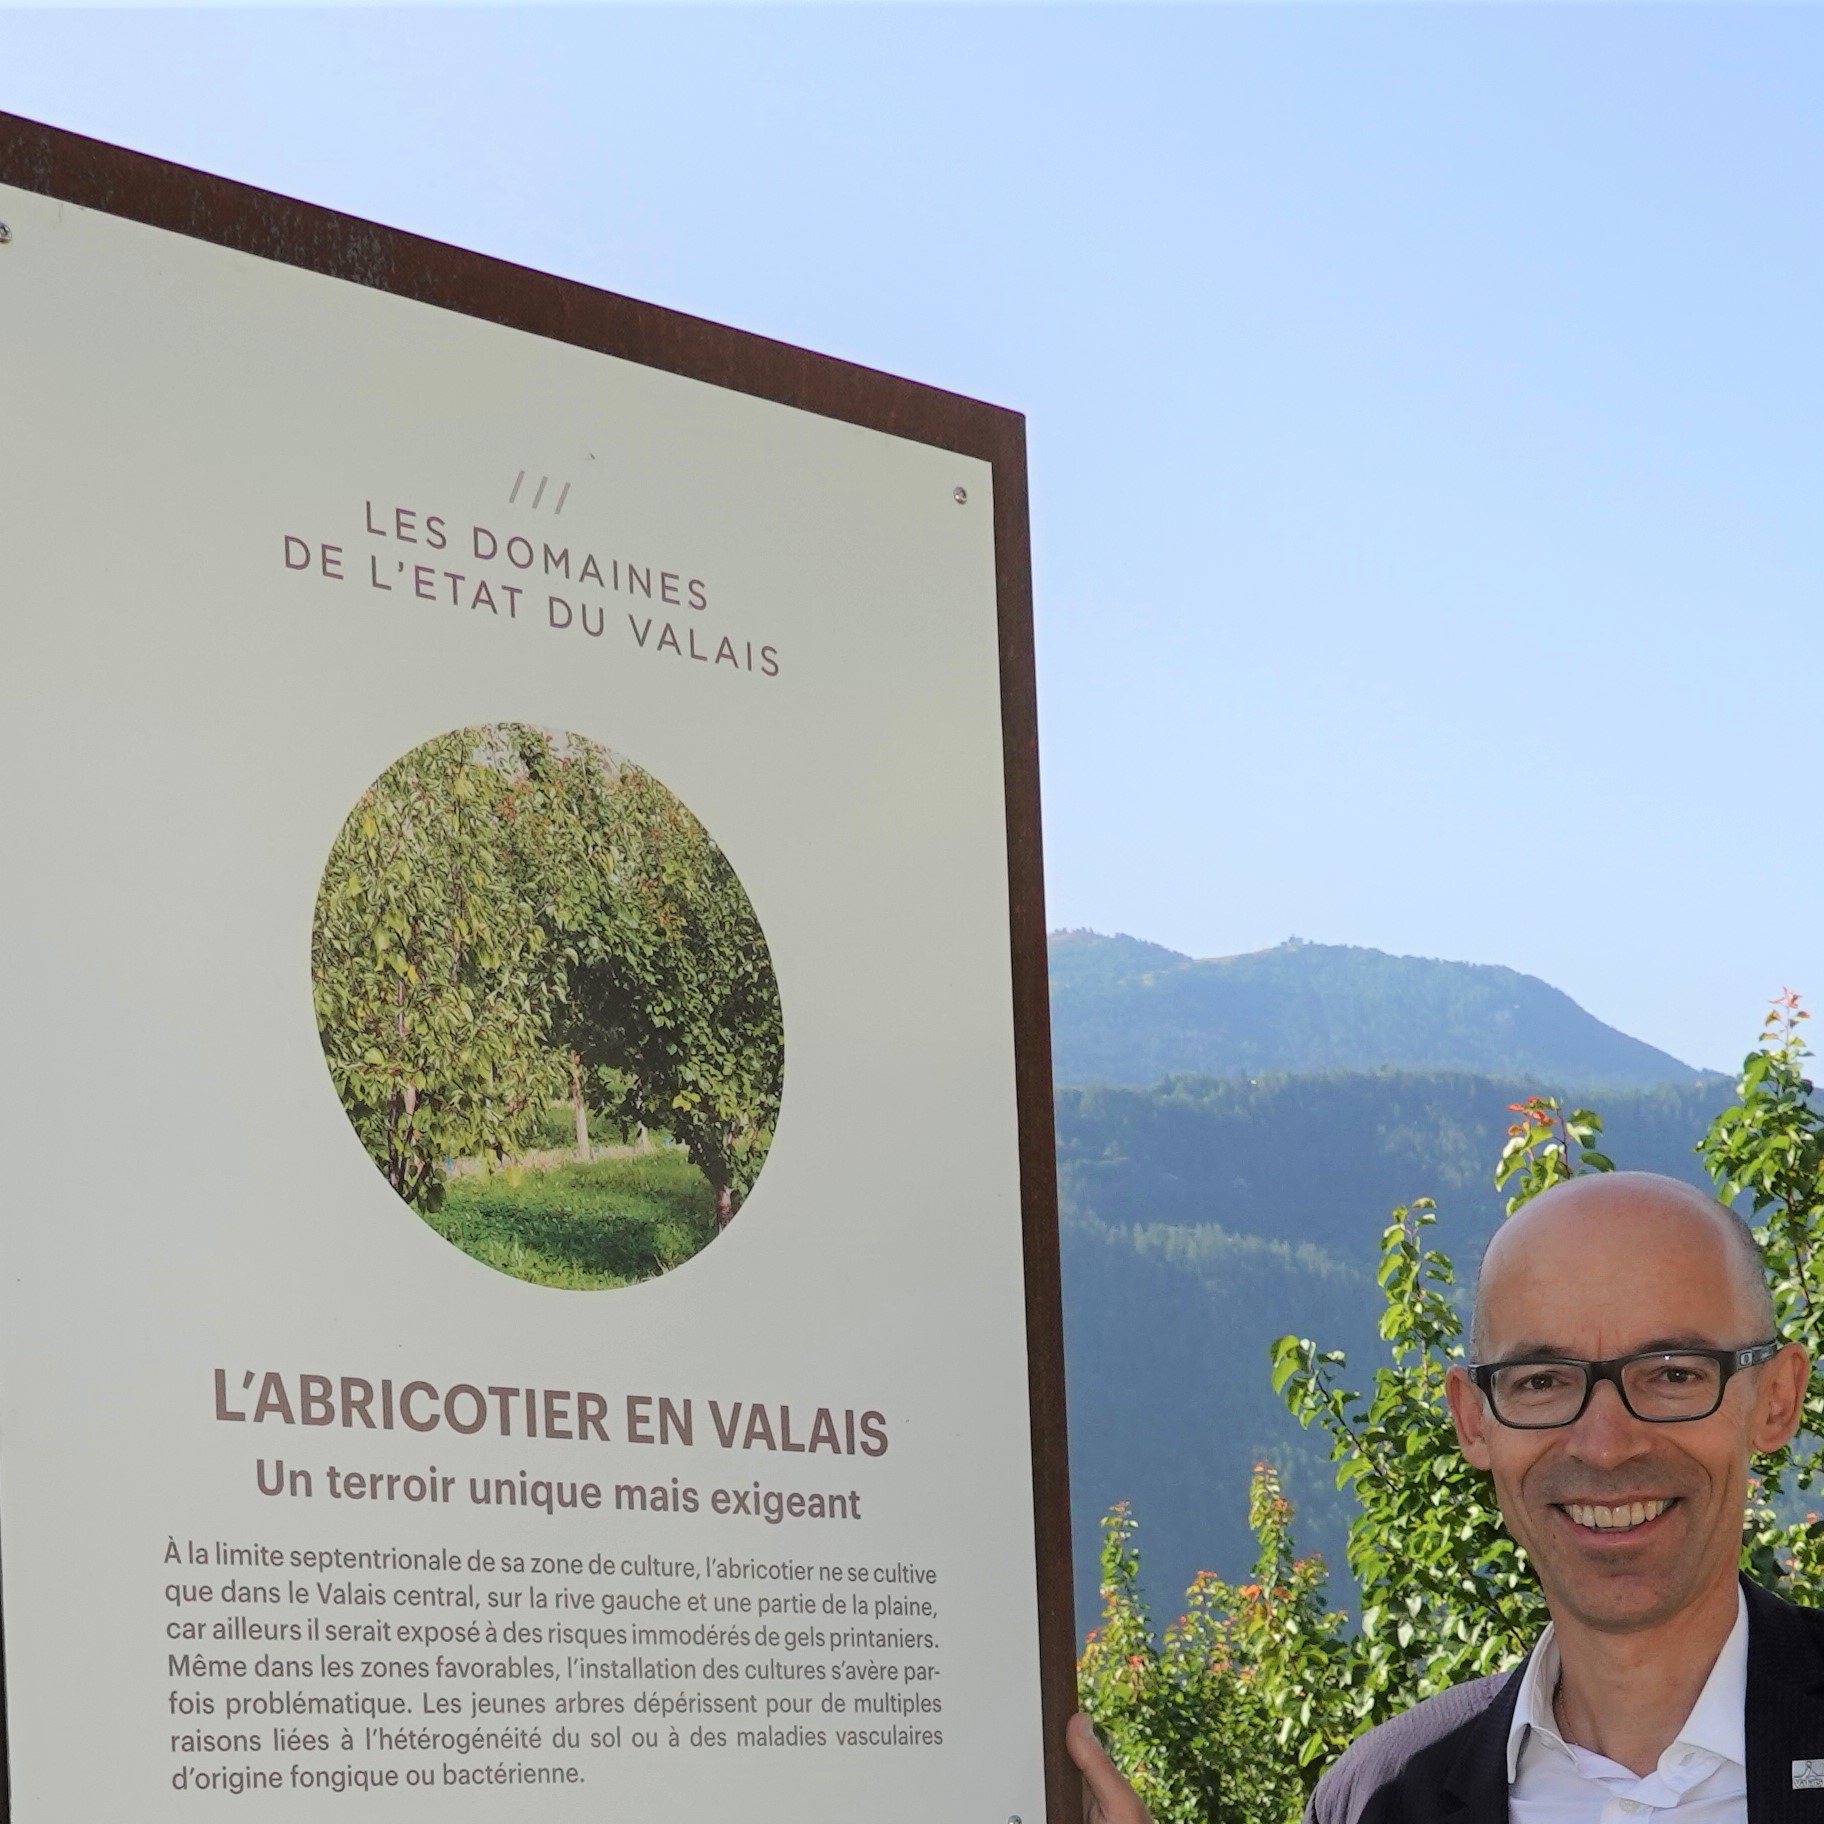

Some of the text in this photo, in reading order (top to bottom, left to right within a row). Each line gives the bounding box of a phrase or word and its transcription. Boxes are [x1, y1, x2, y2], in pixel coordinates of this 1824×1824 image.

[365, 500, 707, 611] LES DOMAINES
[284, 534, 780, 678] DE L'ETAT DU VALAIS
[214, 1368, 889, 1458] L'ABRICOTIER EN VALAIS
[256, 1458, 862, 1525] Un terroir unique mais exigeant
[166, 1615, 939, 1653] car ailleurs il serait exposé à des risques immodérés de gels printaniers.
[168, 1652, 941, 1685] Même dans les zones favorables, l'installation des cultures s'avère par-
[168, 1689, 942, 1720] fois problématique. Les jeunes arbres dépérissent pour de multiples
[171, 1761, 585, 1795] d'origine fongique ou bactérienne.
